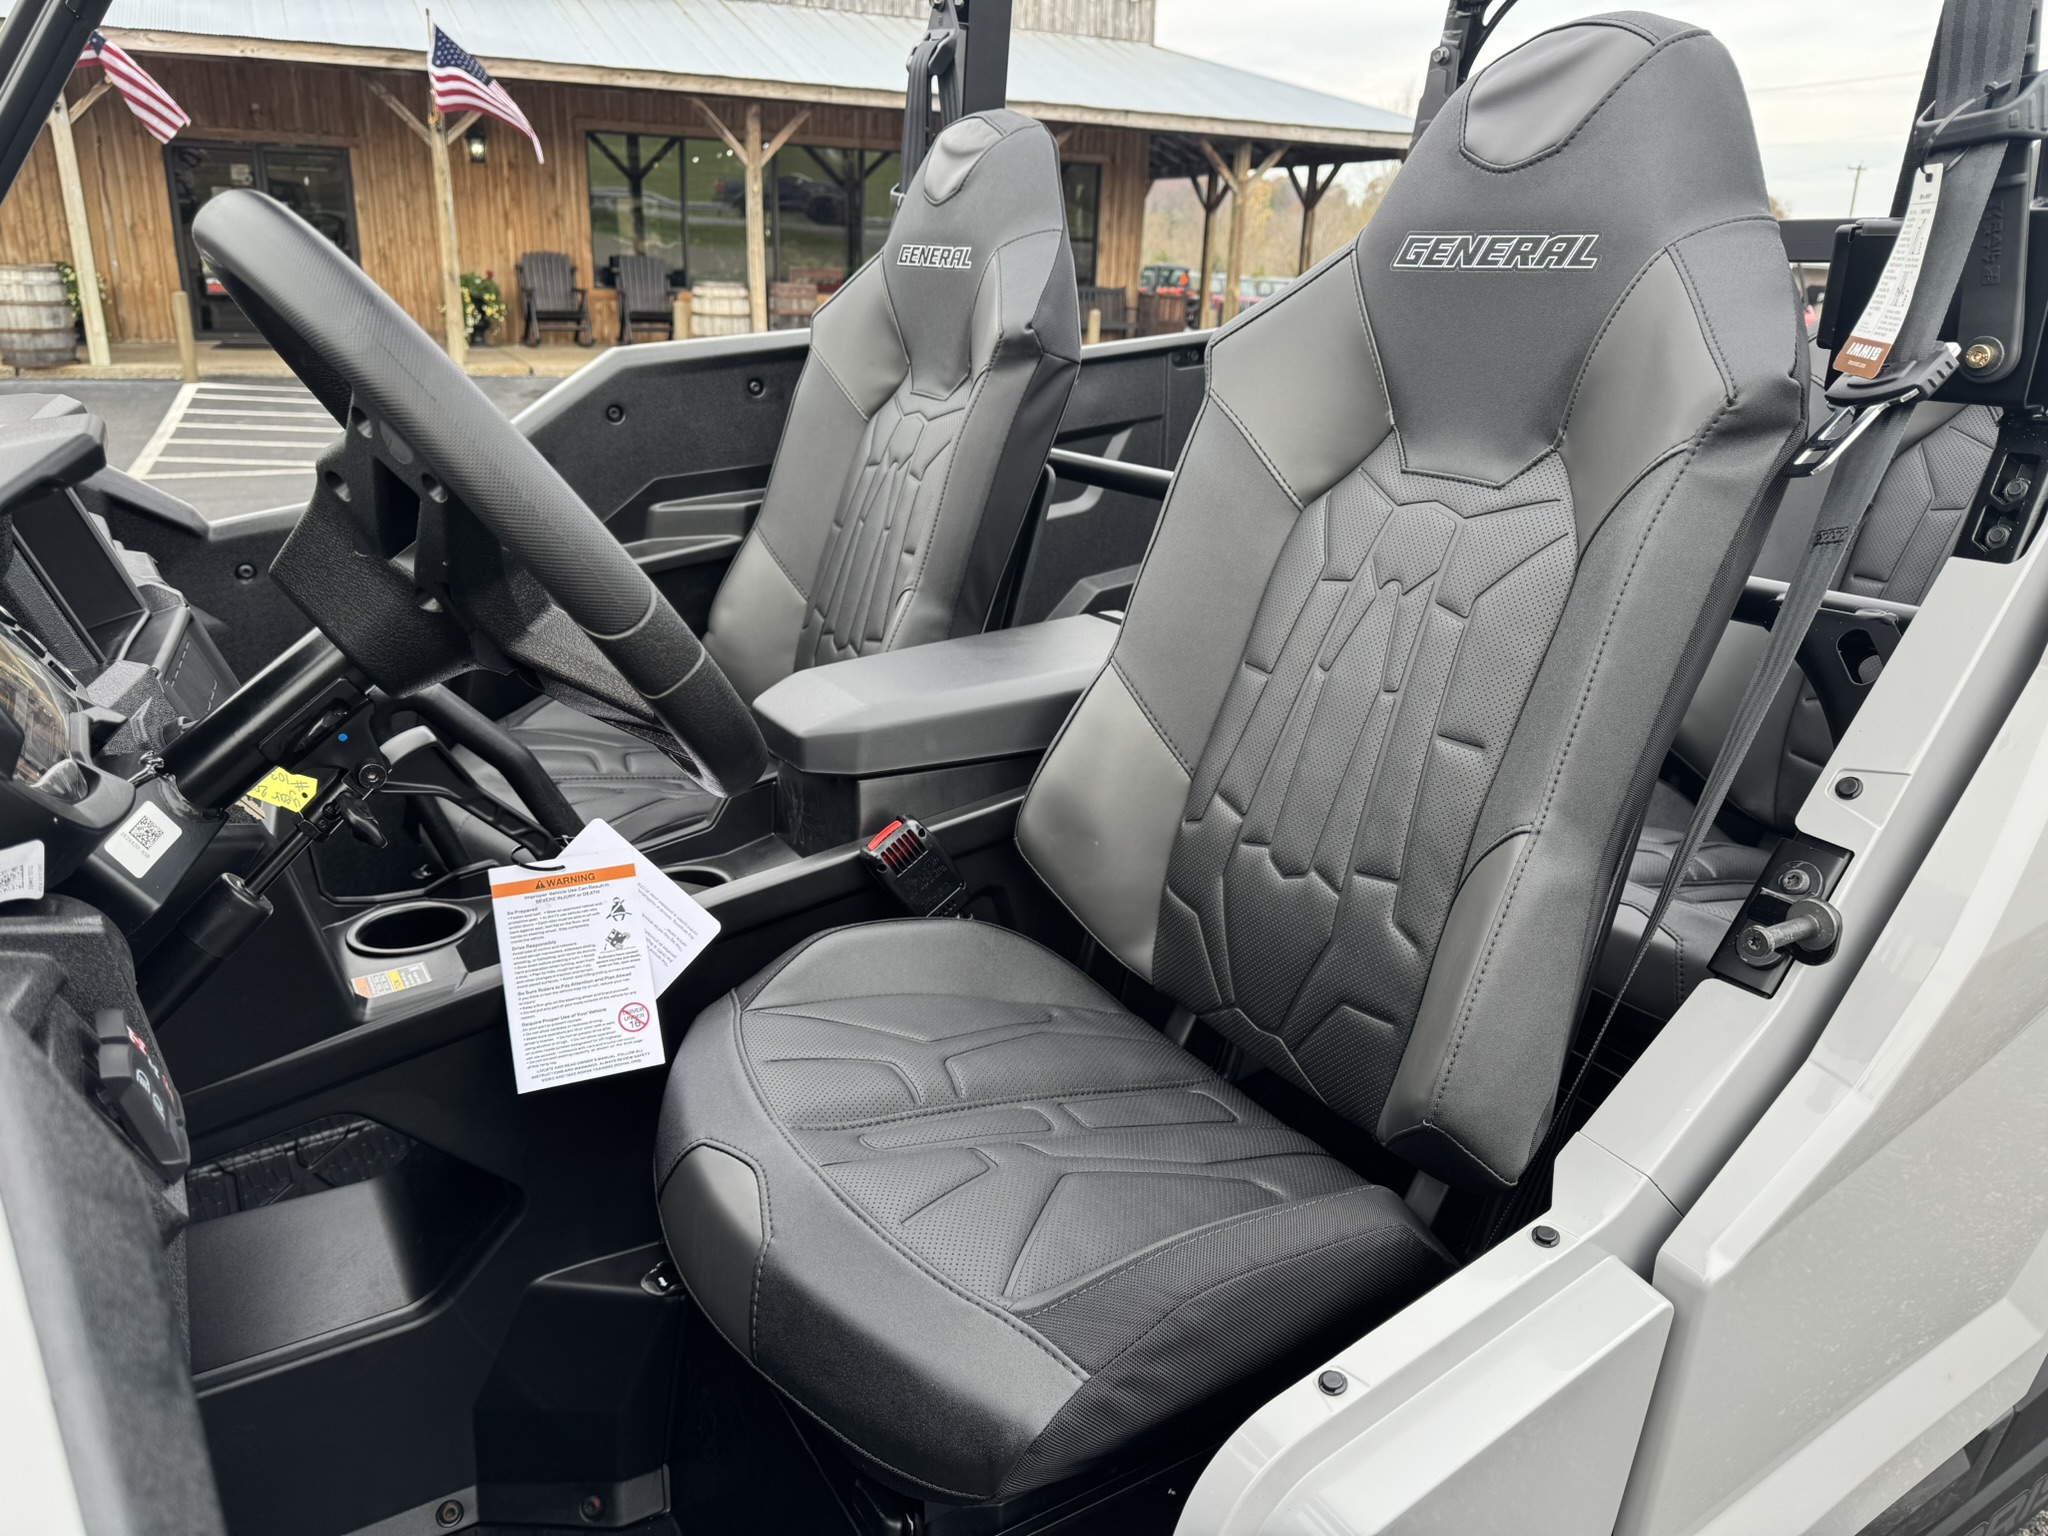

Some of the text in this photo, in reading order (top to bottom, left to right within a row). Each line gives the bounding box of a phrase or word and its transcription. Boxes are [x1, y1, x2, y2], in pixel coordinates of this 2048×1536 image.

[897, 244, 972, 269] GENERAL
[1392, 233, 1601, 269] GENERAL
[546, 873, 595, 887] WARNING
